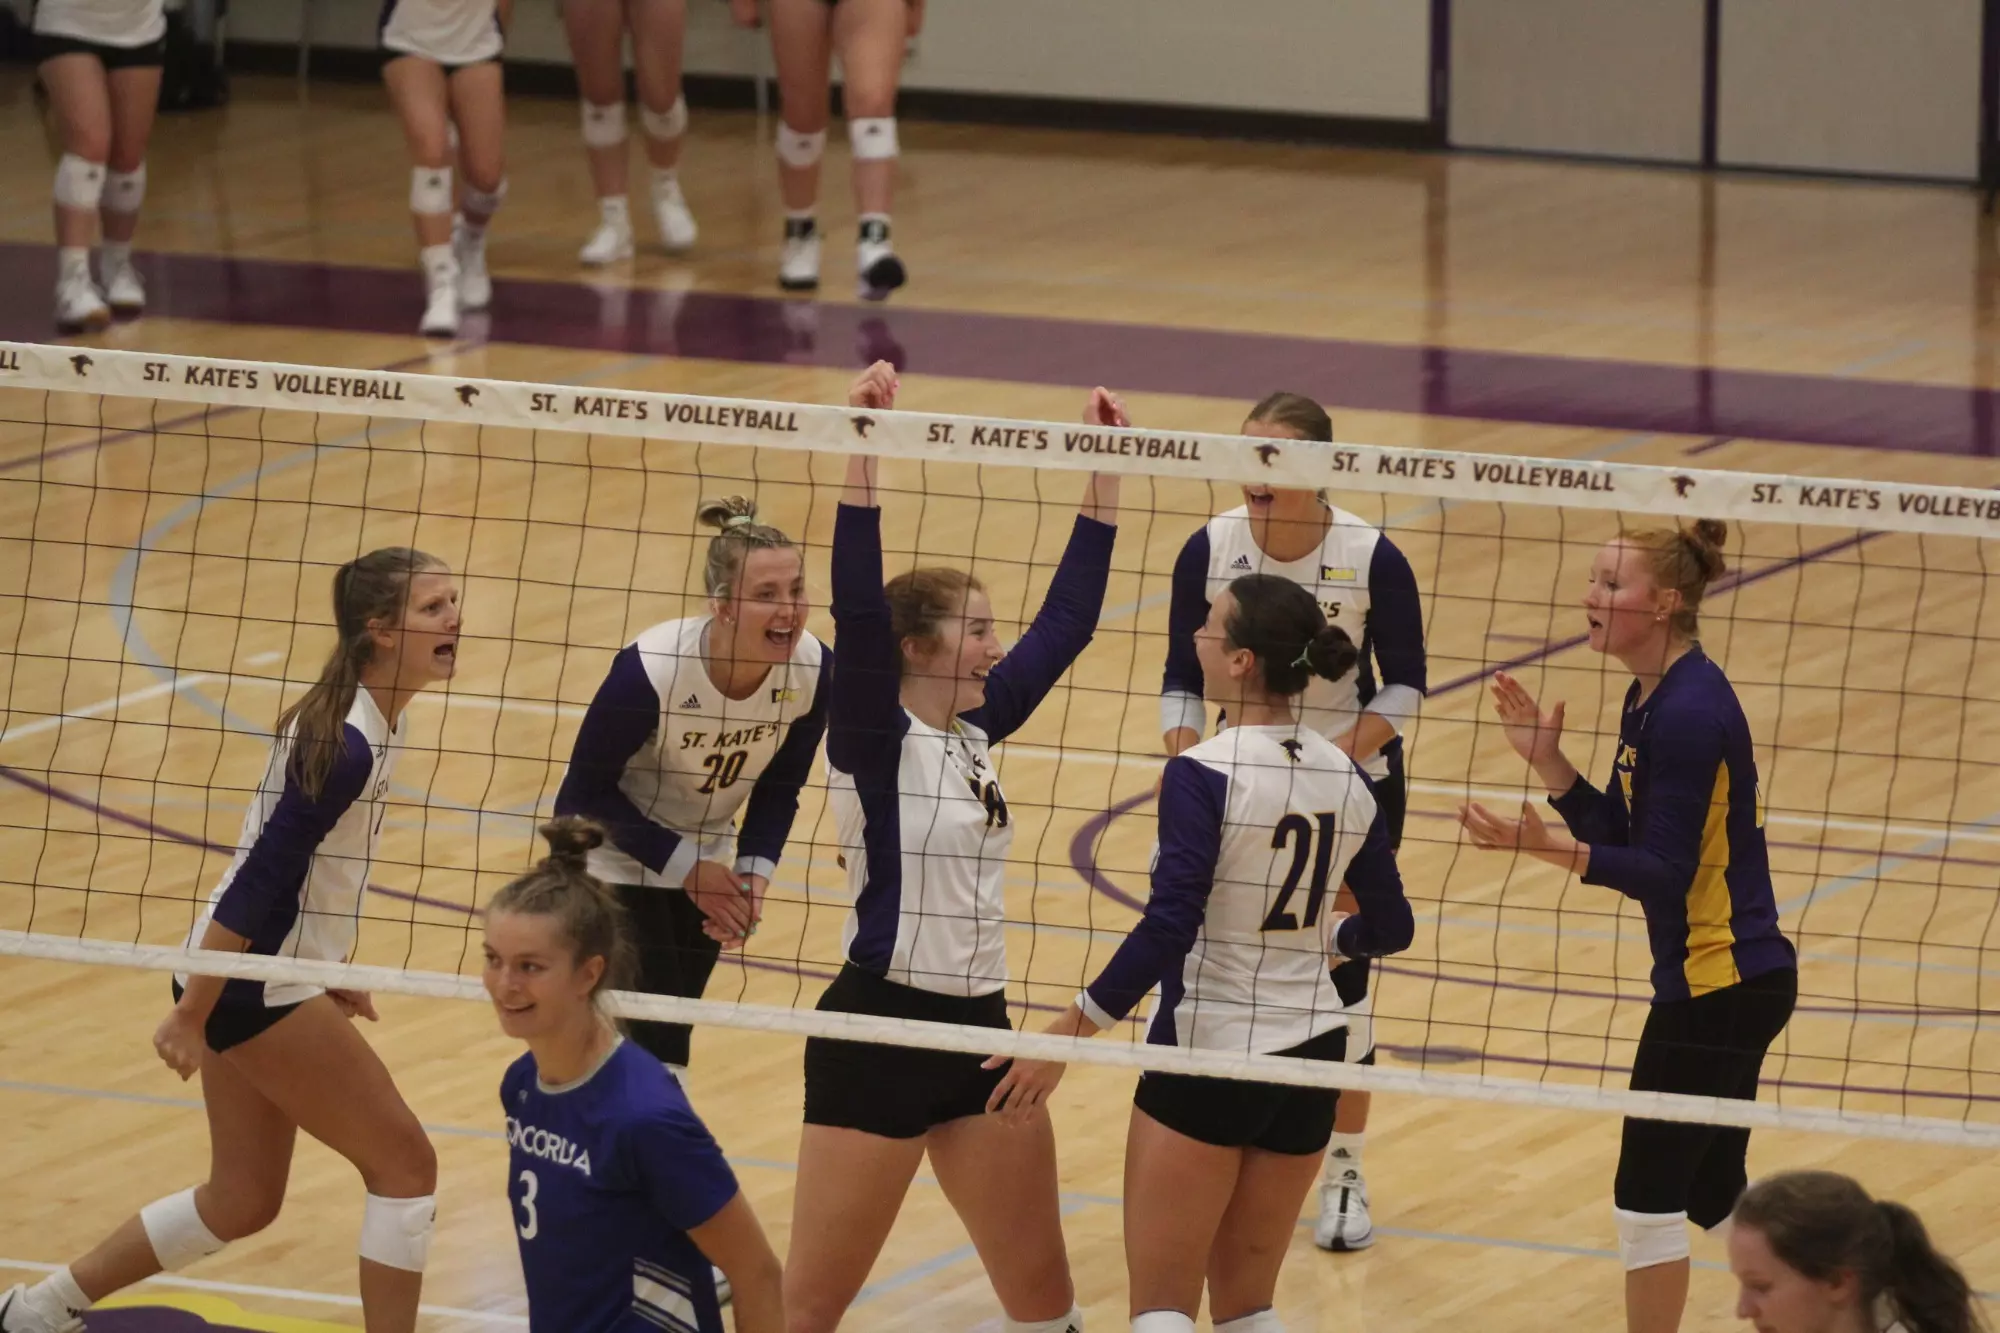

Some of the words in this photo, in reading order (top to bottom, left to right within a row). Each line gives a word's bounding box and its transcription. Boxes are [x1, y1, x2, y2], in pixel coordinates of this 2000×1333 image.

[143, 362, 170, 382] ST.
[185, 366, 258, 390] KATE'S
[274, 372, 405, 401] VOLLEYBALL
[530, 392, 558, 413] ST.
[573, 396, 648, 420] KATE'S
[664, 403, 799, 432] VOLLEYBALL
[926, 423, 955, 444] ST.
[970, 425, 1048, 451] KATE'S
[1064, 432, 1201, 461] VOLLEYBALL
[1332, 451, 1360, 473] ST.
[1376, 454, 1456, 480] KATE'S
[1473, 461, 1616, 491] VOLLEYBALL
[1751, 483, 1783, 504] ST.
[1798, 485, 1882, 511] KATE'S
[680, 731, 709, 750] ST.
[712, 723, 779, 748] KATE'S
[696, 750, 749, 794] 20
[1258, 811, 1336, 932] 21
[518, 1169, 539, 1240] 3
